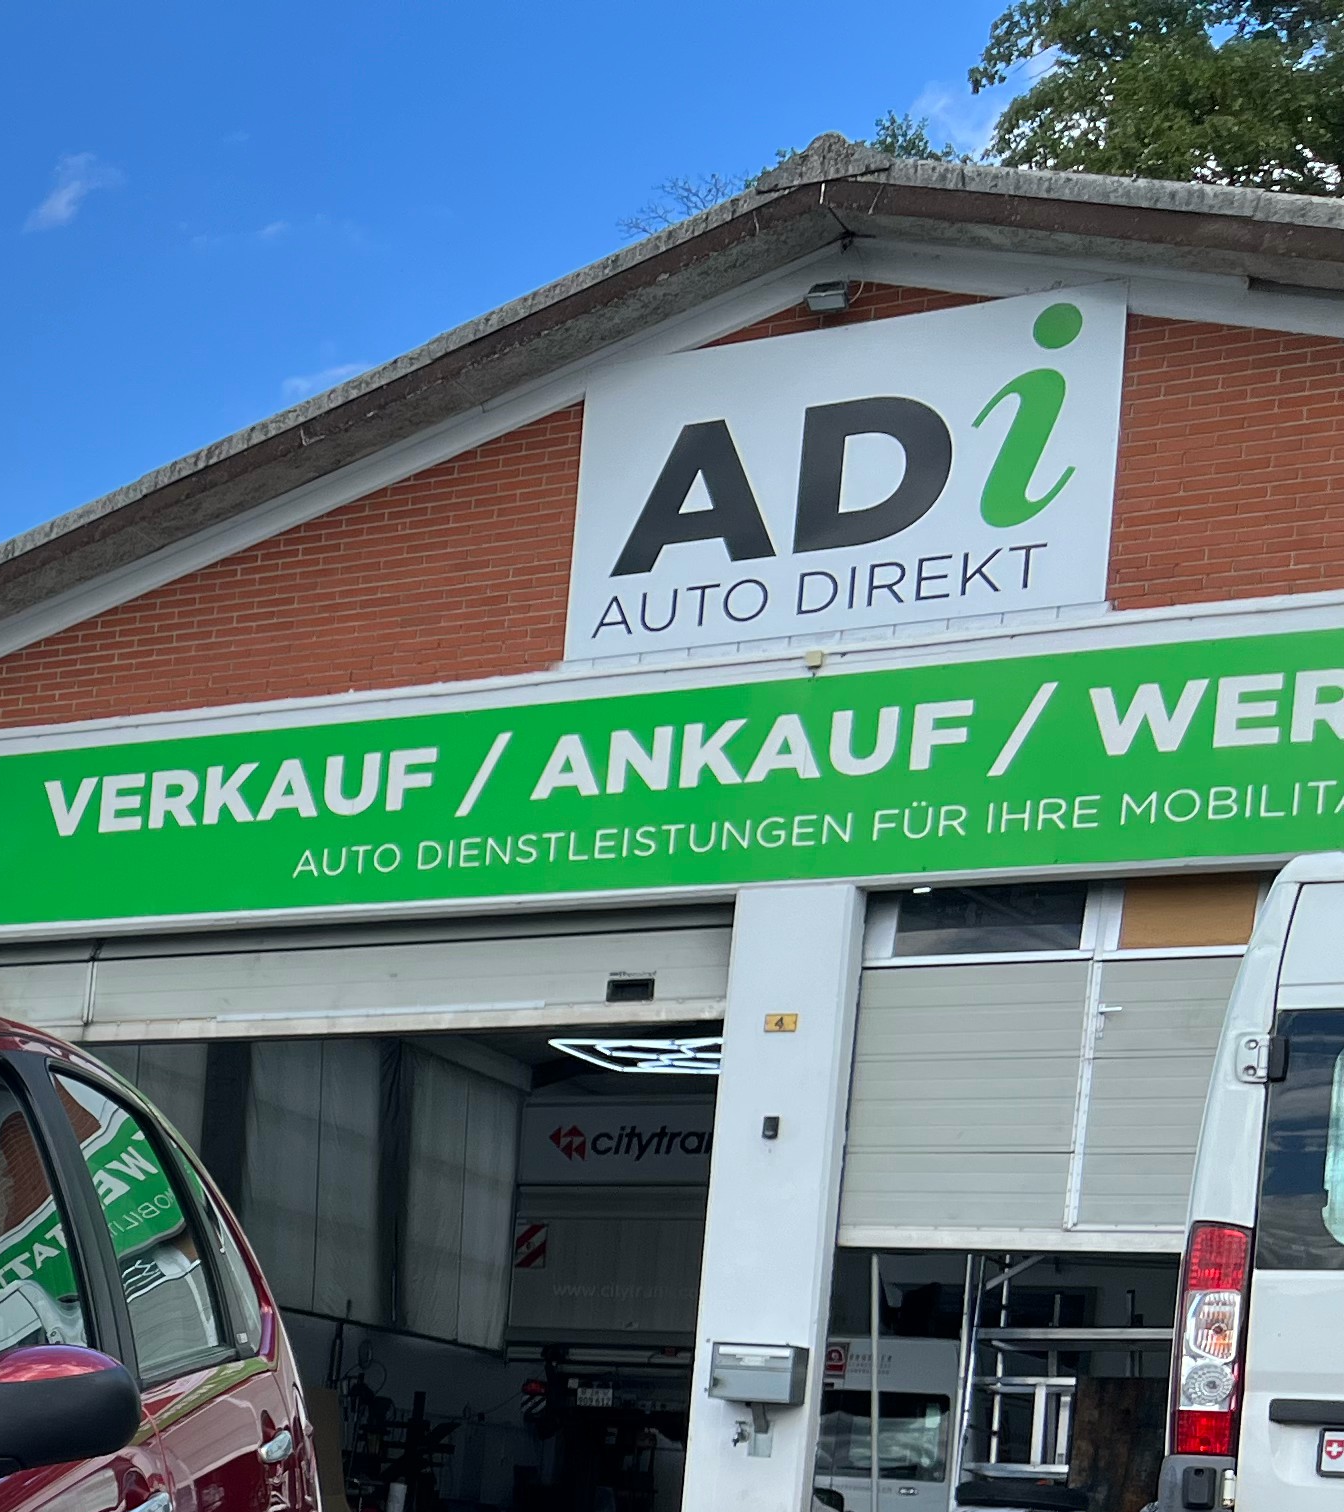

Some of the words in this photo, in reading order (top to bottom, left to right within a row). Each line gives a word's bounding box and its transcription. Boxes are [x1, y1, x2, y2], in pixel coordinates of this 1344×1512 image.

[591, 578, 769, 640] AUTO
[795, 541, 1048, 617] DIREKT
[43, 746, 439, 837] VERKAUF
[529, 699, 975, 801] ANKAUF
[291, 843, 402, 879] AUTO
[417, 812, 854, 871] DIENSTLEISTUNGEN
[872, 801, 968, 842] FÜR
[986, 795, 1101, 835] IHRE
[1119, 780, 1344, 826] MOBILIT
[774, 1016, 784, 1030] 4
